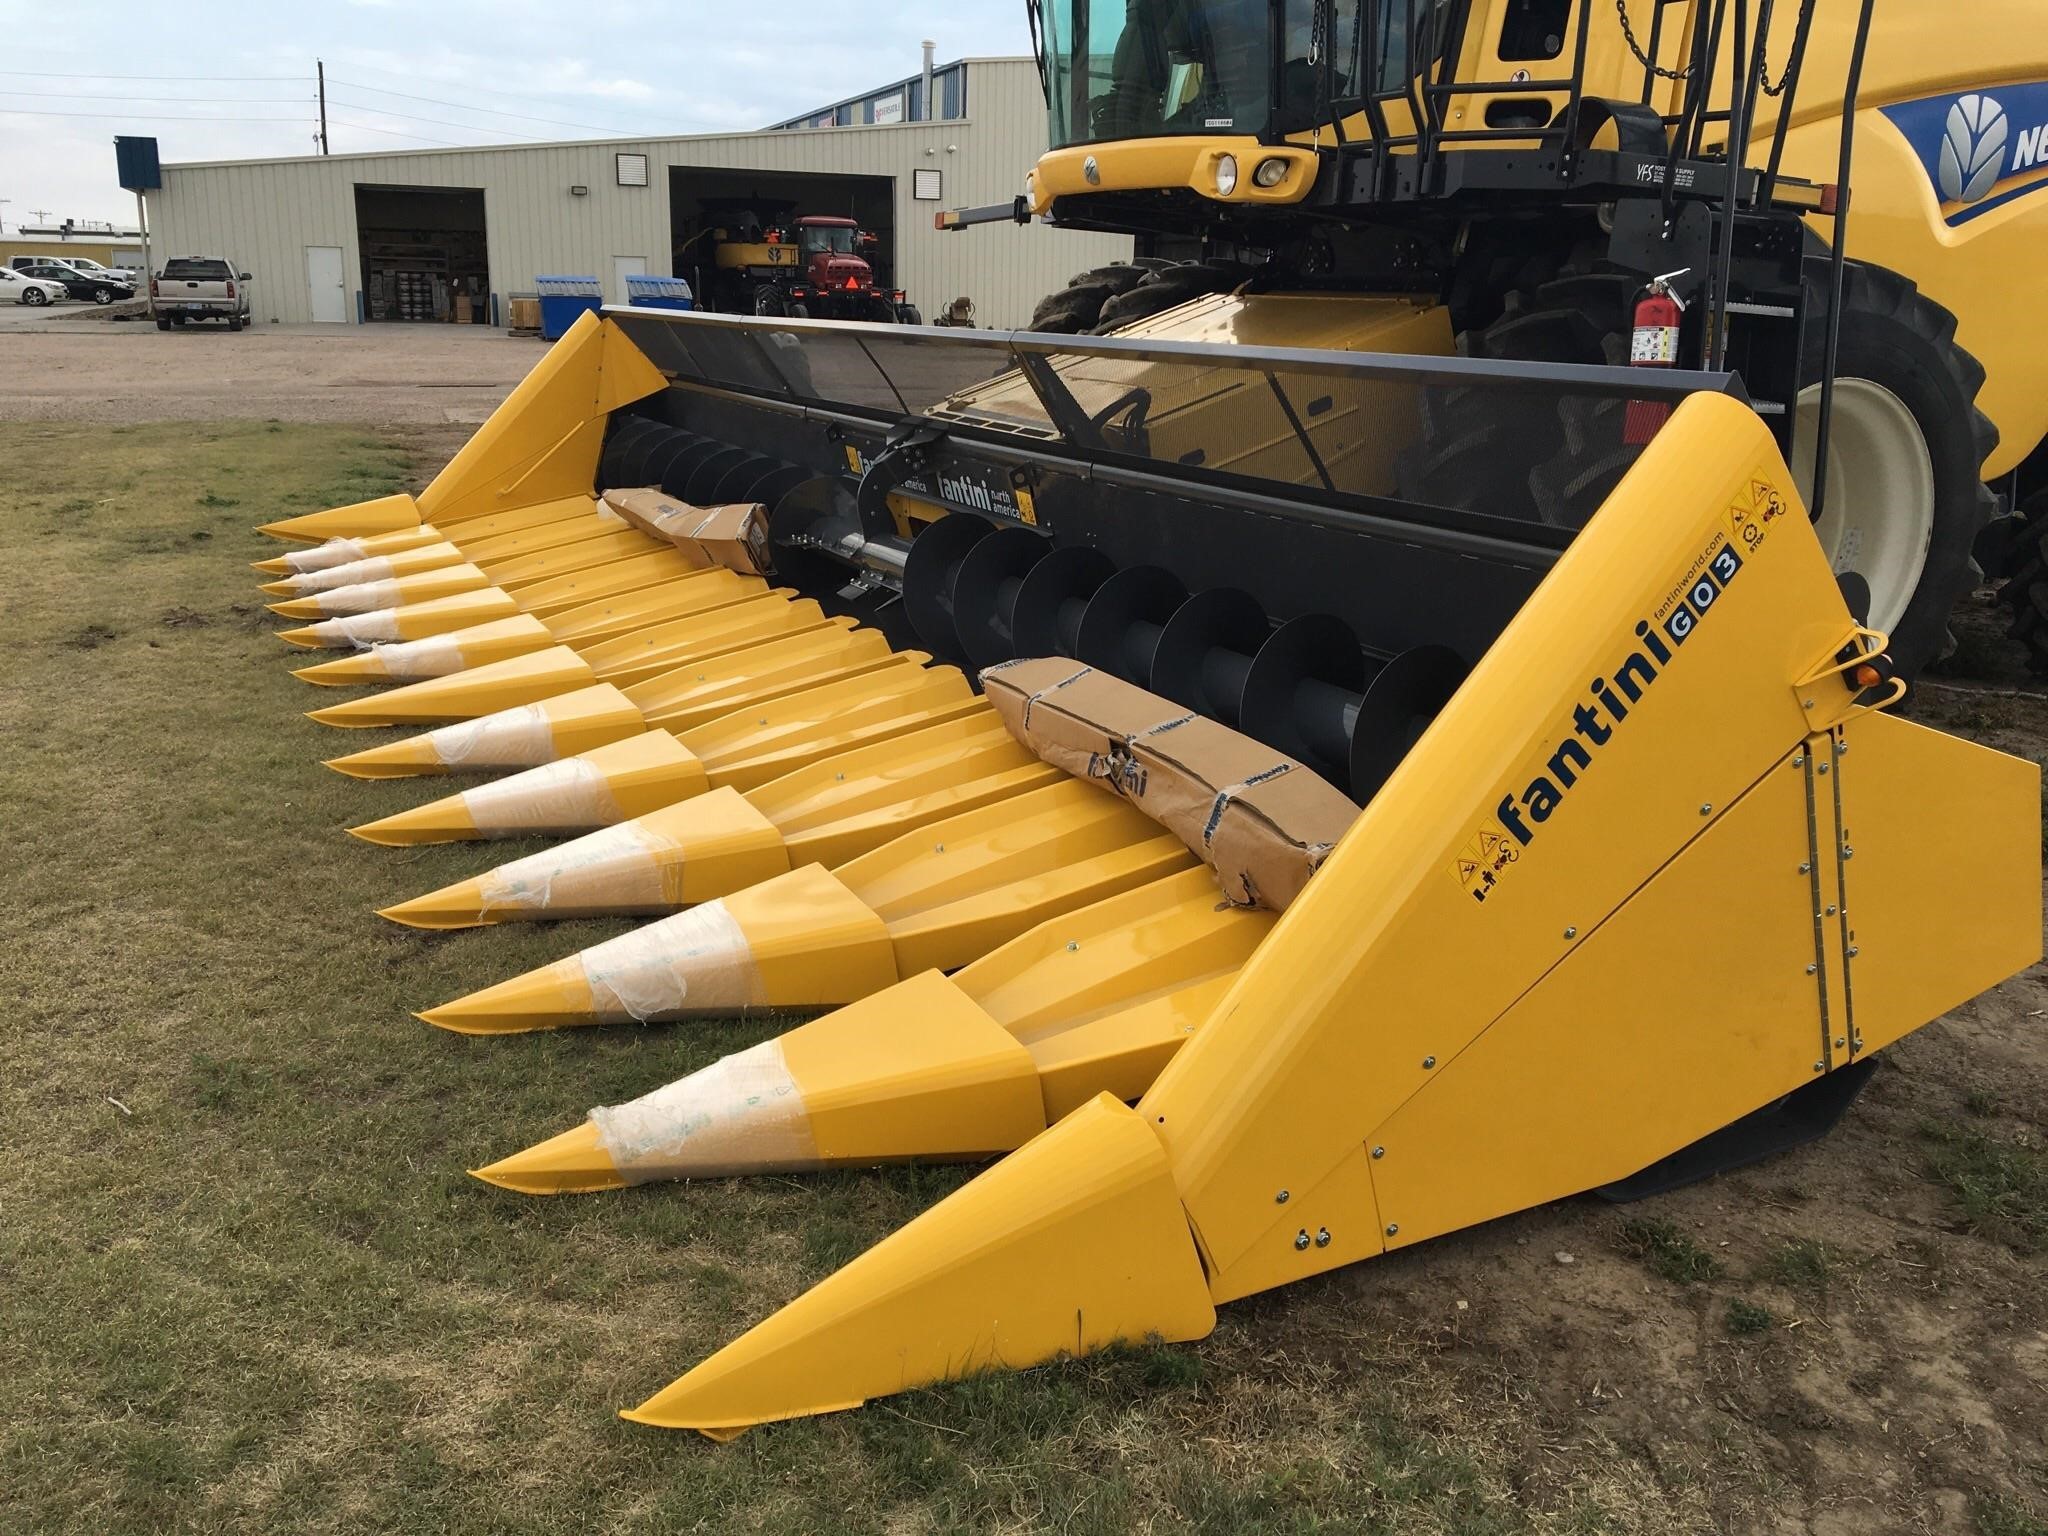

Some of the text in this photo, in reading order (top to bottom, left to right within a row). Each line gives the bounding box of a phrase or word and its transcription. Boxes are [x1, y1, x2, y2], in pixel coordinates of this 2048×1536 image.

[1637, 163, 1654, 181] YFS
[993, 502, 1020, 519] america
[1653, 530, 1725, 621] fantiniworld.com
[1496, 619, 1673, 848] fantini
